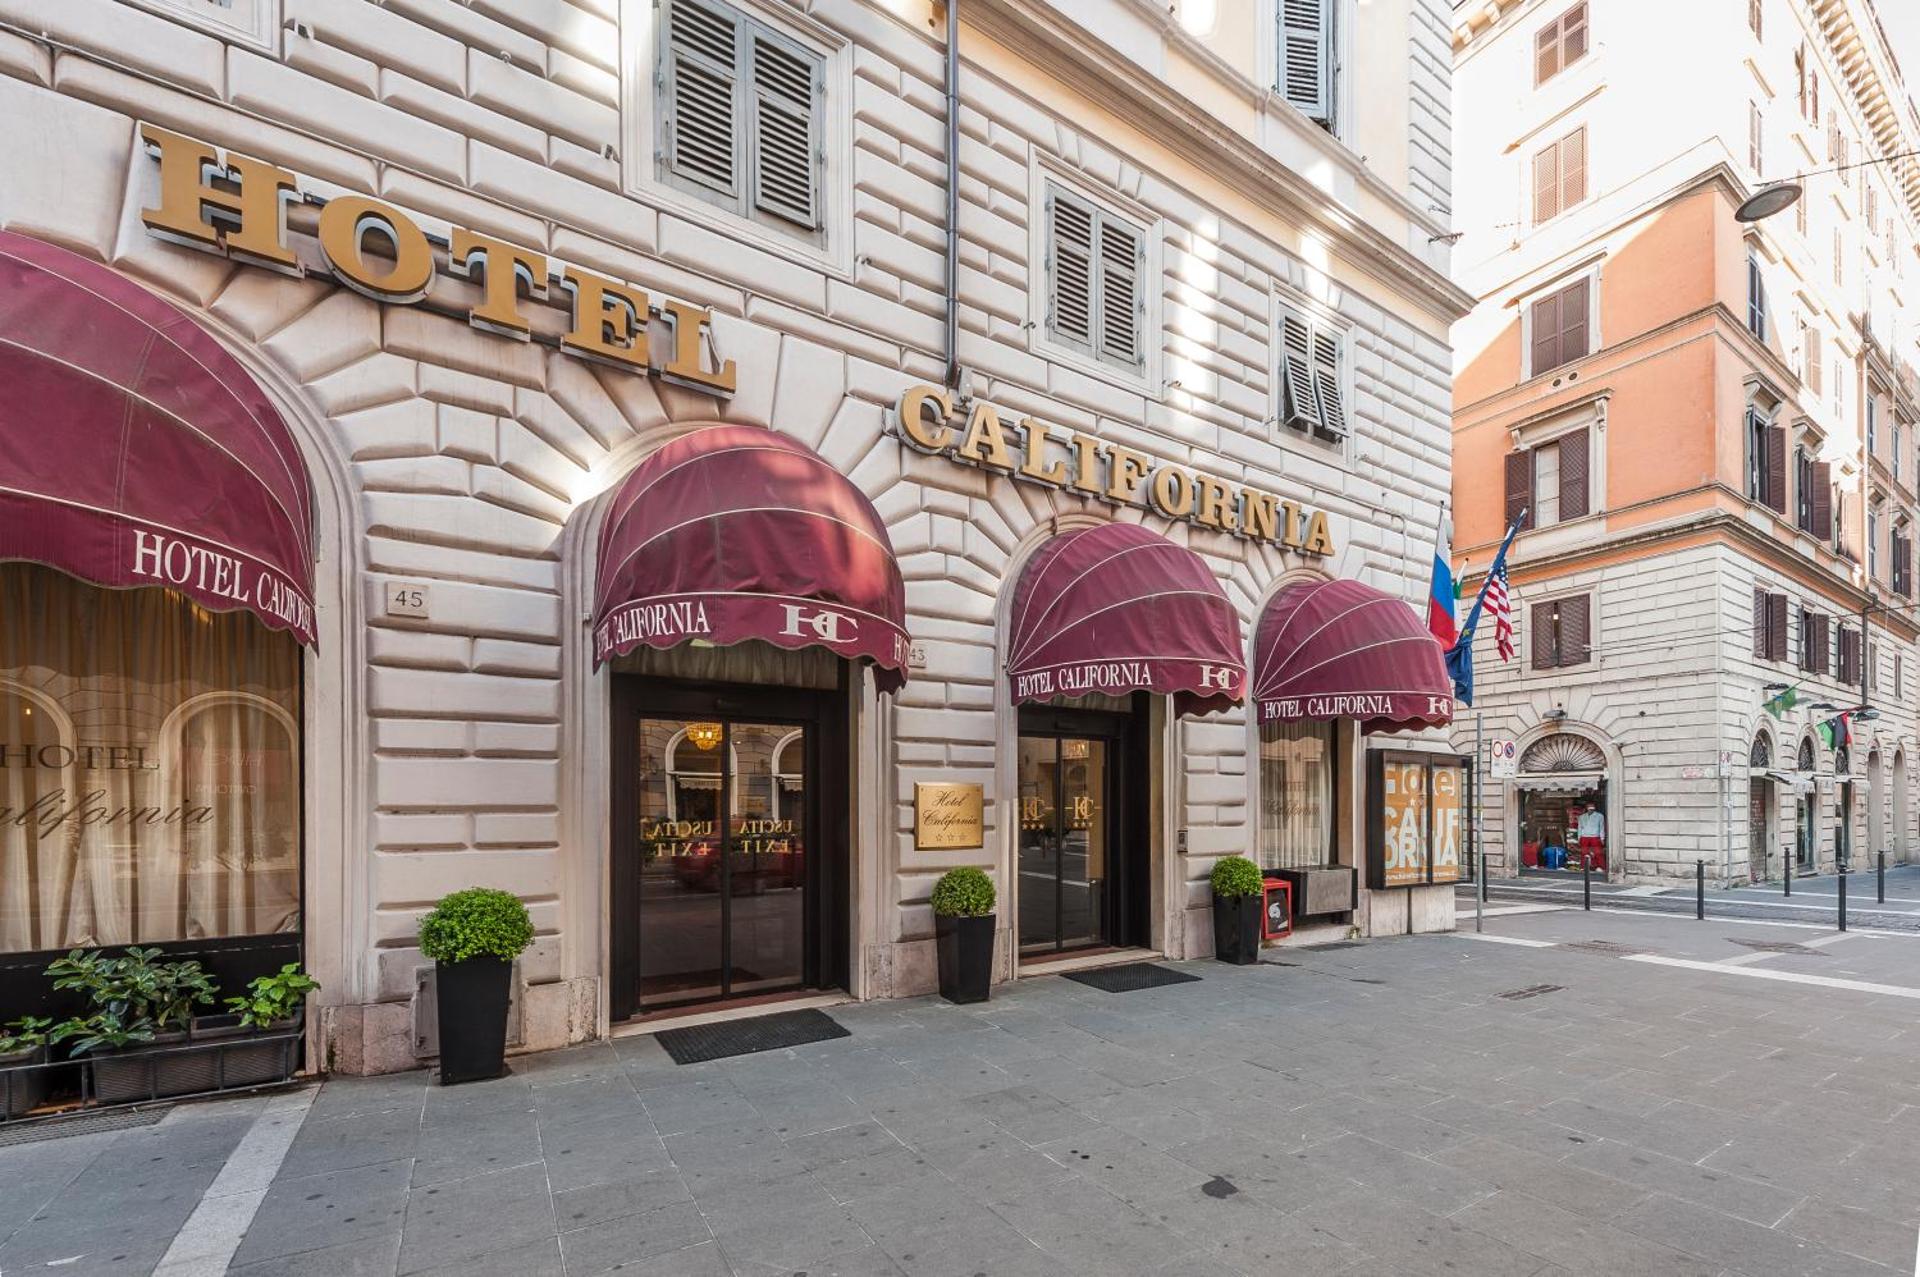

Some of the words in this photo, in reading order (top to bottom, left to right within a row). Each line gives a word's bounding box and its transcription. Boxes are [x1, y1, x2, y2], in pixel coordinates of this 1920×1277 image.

[140, 124, 736, 399] HOTEL
[899, 385, 1336, 557] CALIFORNIA
[132, 529, 250, 603] HOTEL
[395, 590, 424, 608] 45
[909, 647, 926, 662] 43
[1017, 671, 1054, 697] HOTEL
[1058, 663, 1153, 690] CALIFORNIA
[1264, 700, 1304, 719] HOTEL
[1307, 695, 1393, 717] CALIFORNIA
[0, 743, 161, 770] HOTEL
[931, 790, 970, 807] Hotel
[0, 788, 216, 841] alifornia
[922, 809, 978, 832] California
